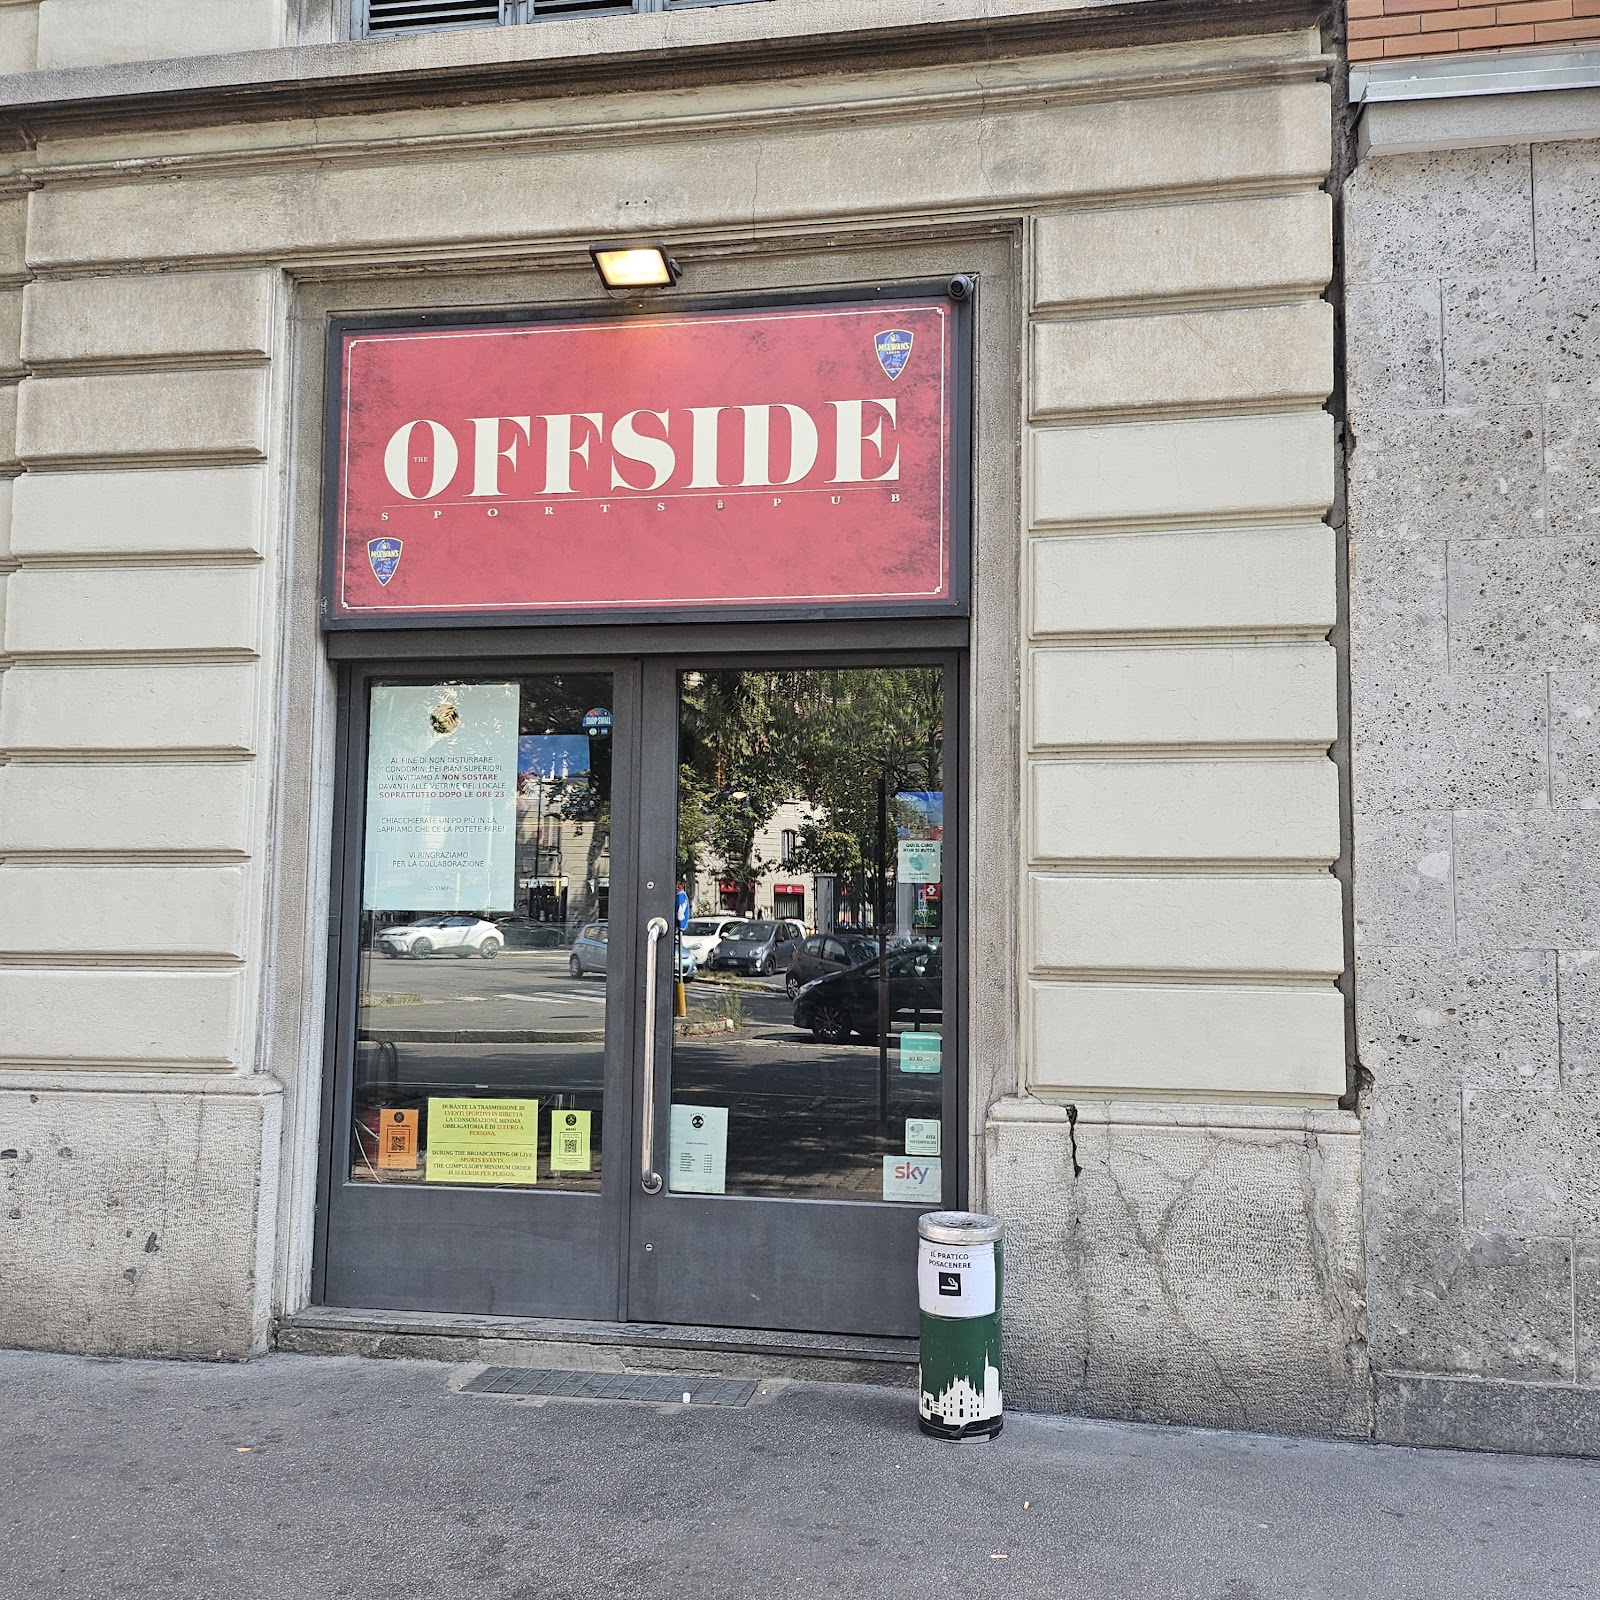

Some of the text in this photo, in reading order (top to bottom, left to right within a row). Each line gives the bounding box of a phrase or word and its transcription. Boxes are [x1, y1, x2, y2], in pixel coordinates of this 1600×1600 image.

[383, 398, 900, 500] OFFSIDE
[413, 456, 429, 464] THE
[381, 493, 901, 521] SPORTS PUB
[585, 716, 612, 725] SHOP SMALL
[392, 860, 485, 868] PER LA COLLABORAZIONE
[895, 1161, 929, 1185] sky
[930, 1250, 969, 1260] IL PRATICO
[928, 1259, 972, 1269] POSACENERE
